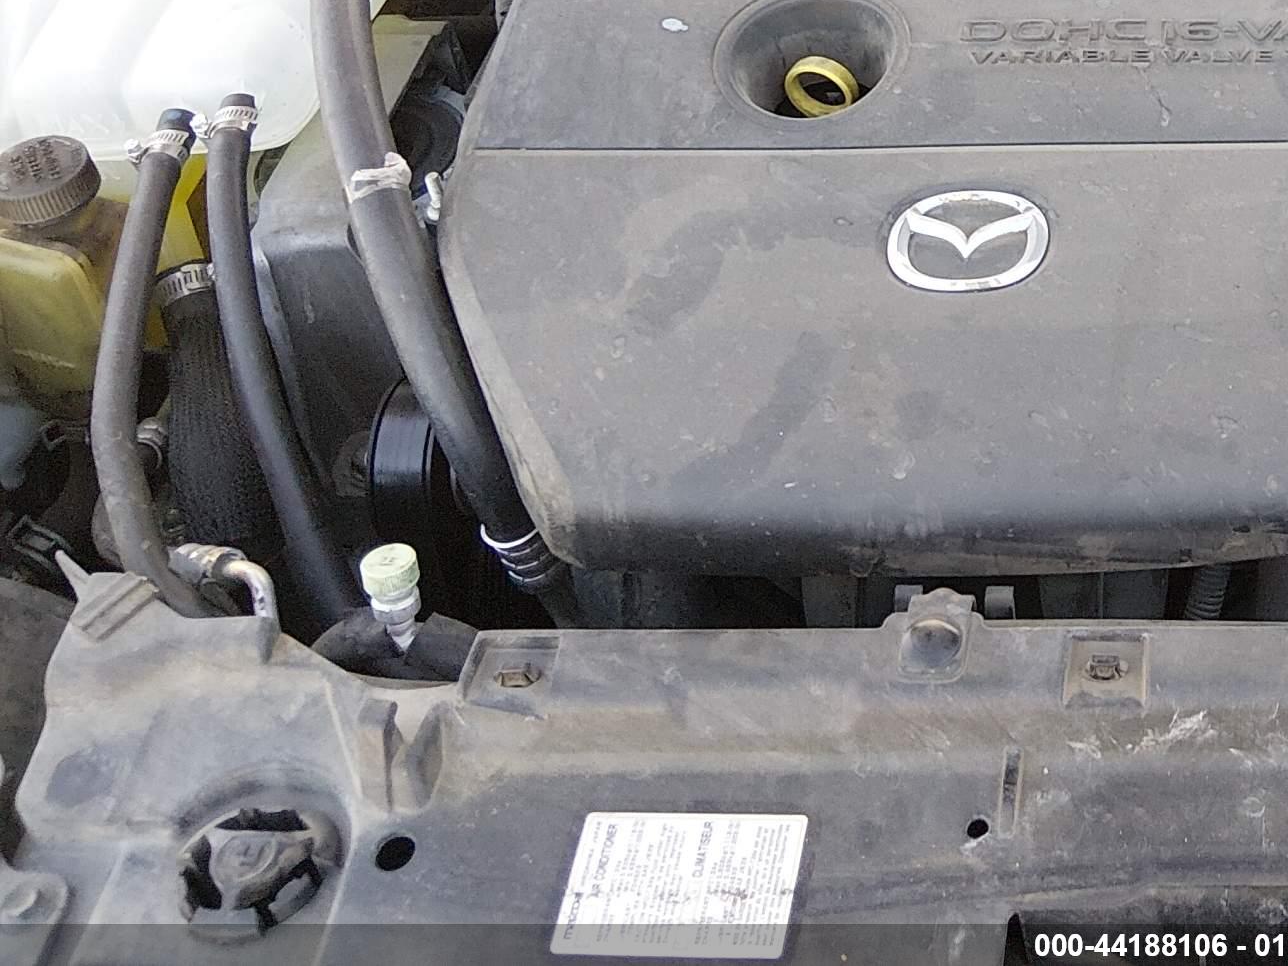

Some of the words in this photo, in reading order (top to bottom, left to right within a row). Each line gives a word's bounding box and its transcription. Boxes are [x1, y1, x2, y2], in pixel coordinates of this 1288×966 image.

[960, 18, 1147, 44] DOHC
[969, 49, 1152, 65] VARIABLE
[1162, 48, 1274, 64] VALVE
